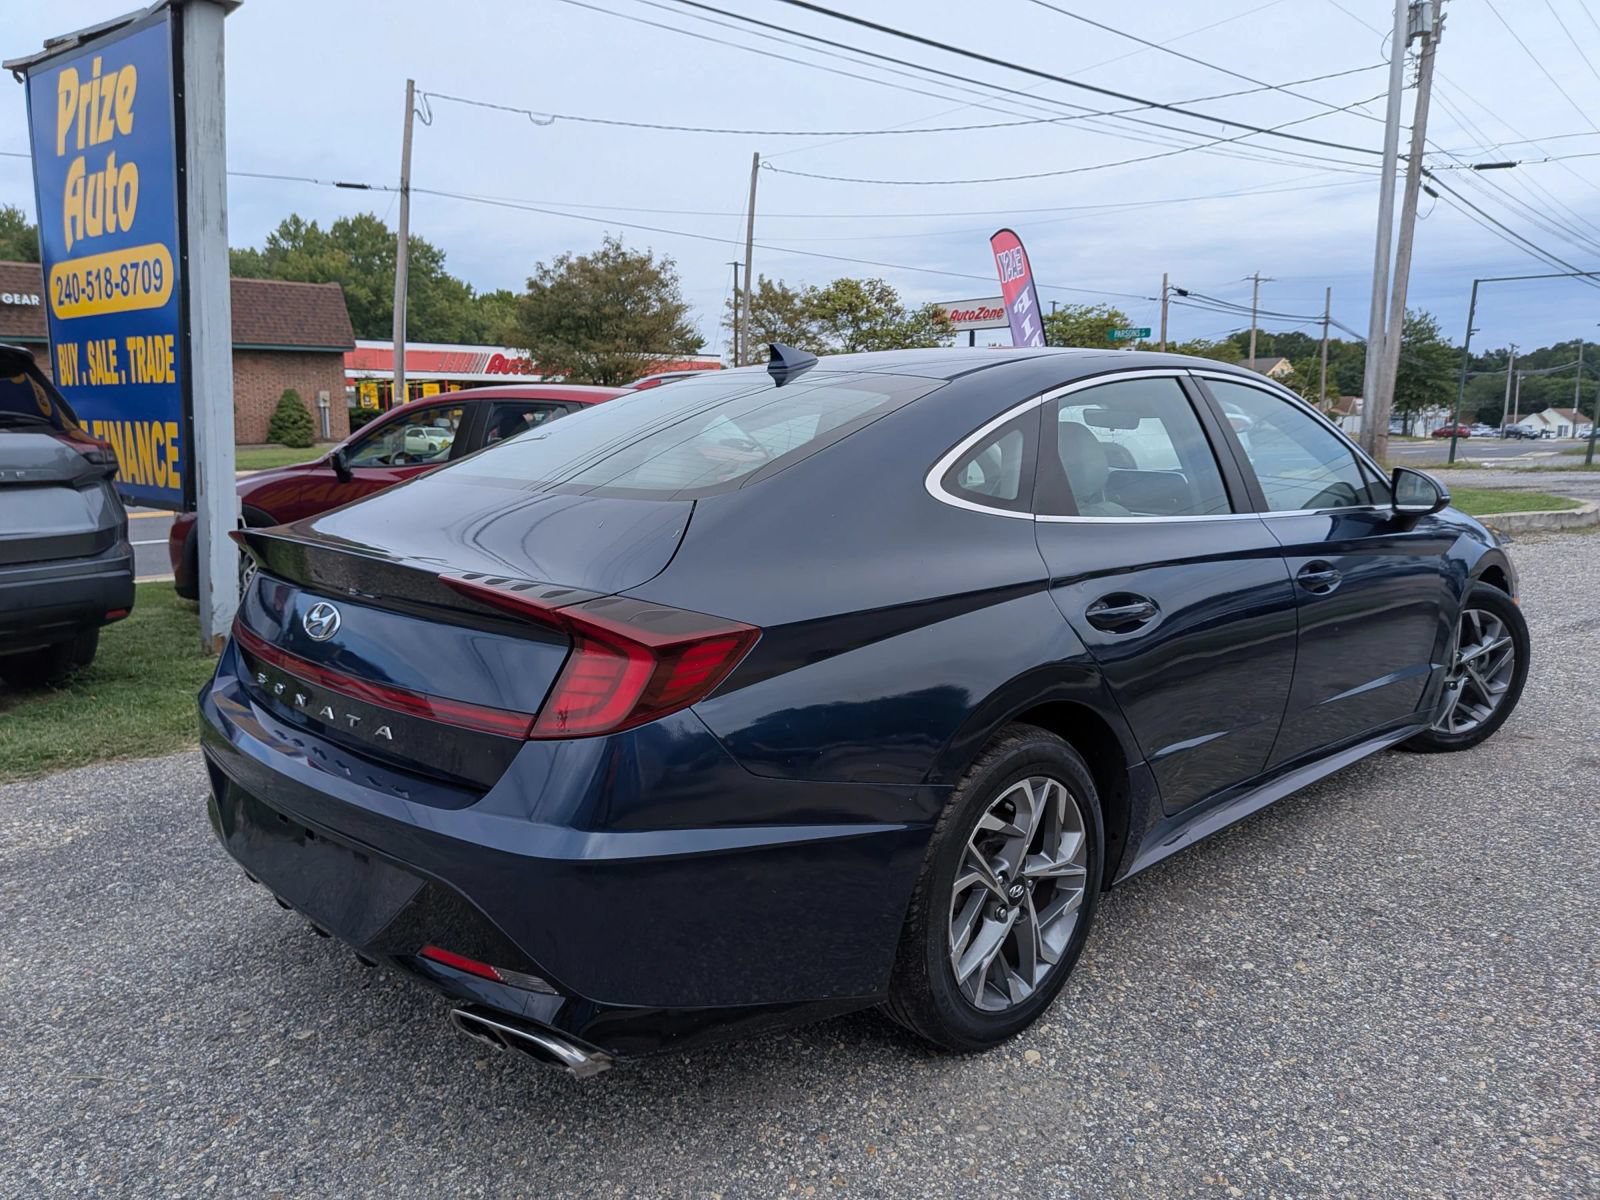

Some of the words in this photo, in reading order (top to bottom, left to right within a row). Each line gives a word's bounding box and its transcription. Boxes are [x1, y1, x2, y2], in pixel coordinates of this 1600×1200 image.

[57, 56, 137, 157] Prize
[64, 151, 138, 254] Auto
[2, 293, 40, 305] GEAR
[56, 258, 163, 306] 240-518-8709
[950, 306, 1004, 321] AutoZone
[57, 343, 79, 386] BUY
[87, 339, 119, 385] SALE
[126, 334, 176, 384] TRADE
[257, 672, 393, 740] SONATA
